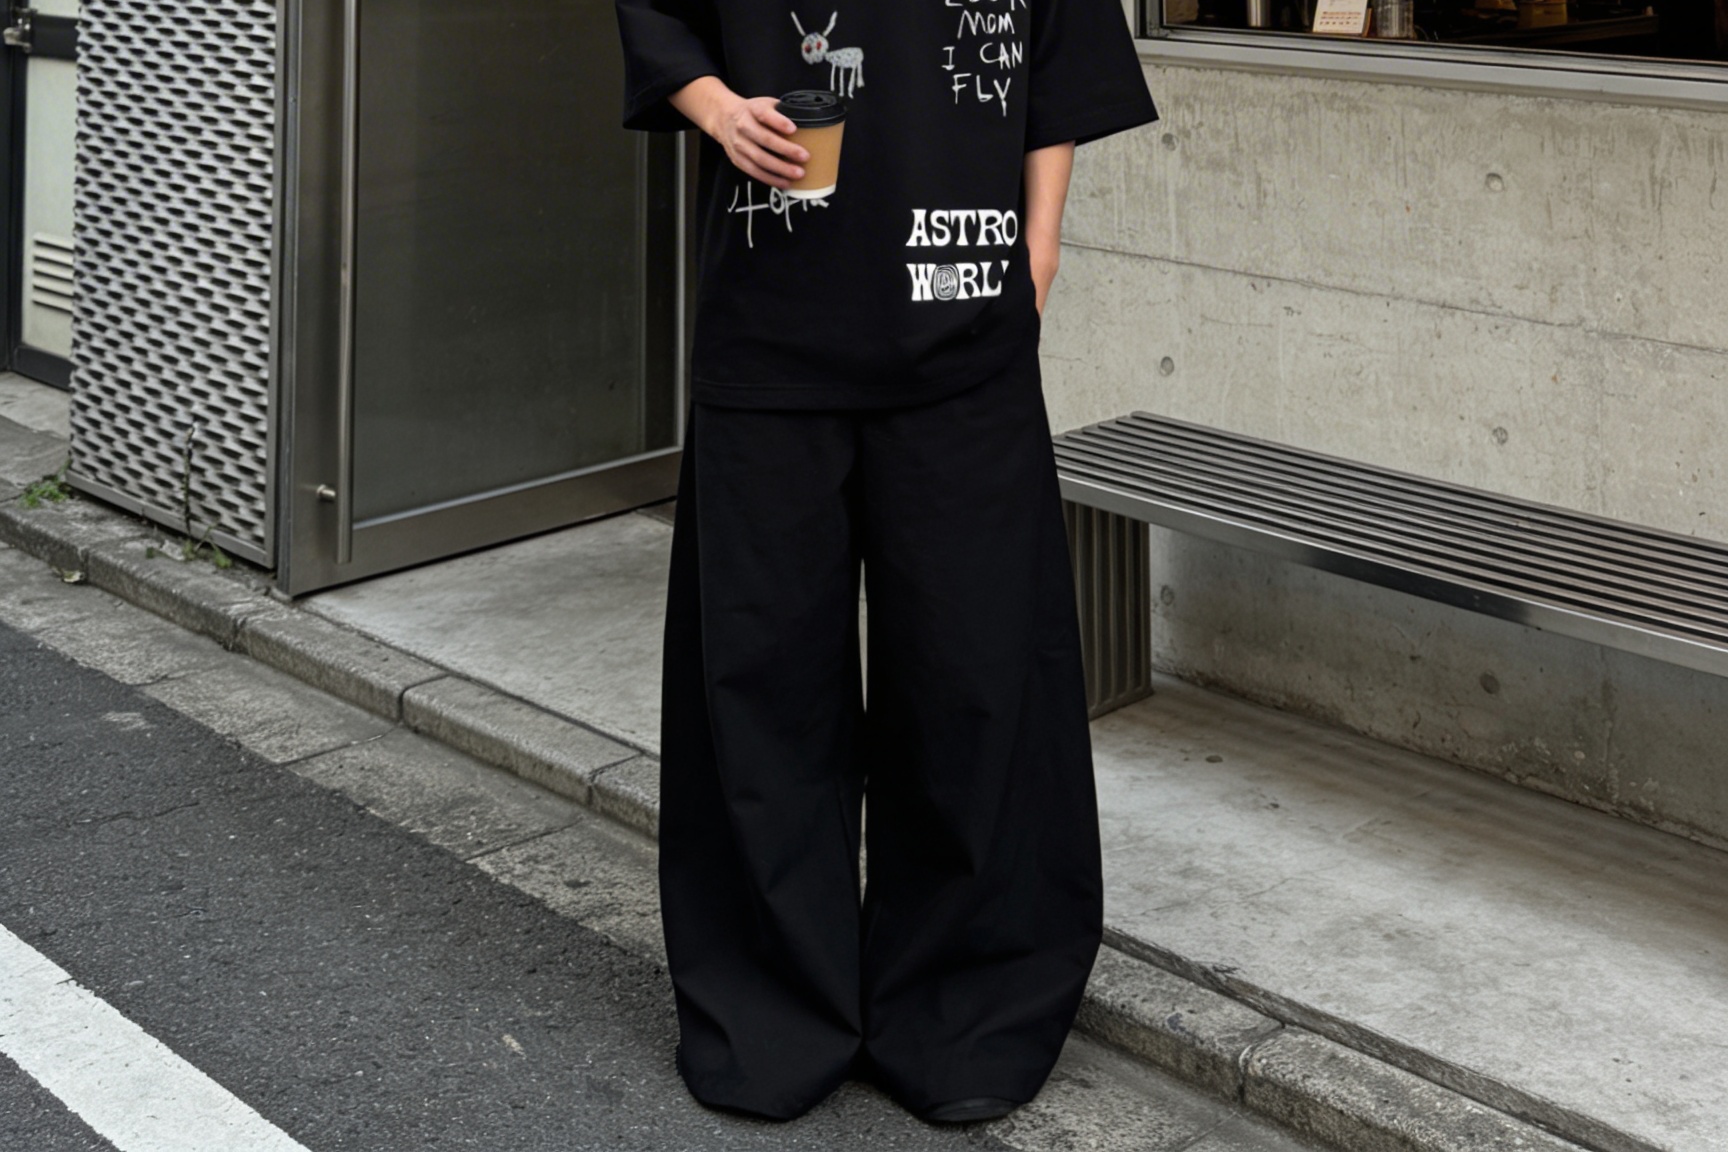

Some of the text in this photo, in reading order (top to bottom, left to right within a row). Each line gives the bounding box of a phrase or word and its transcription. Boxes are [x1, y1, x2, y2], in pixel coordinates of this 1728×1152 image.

[956, 9, 1016, 39] MOM
[941, 41, 1023, 71] I CAN
[951, 72, 1012, 117] FLY
[905, 208, 1019, 248] ASTRO
